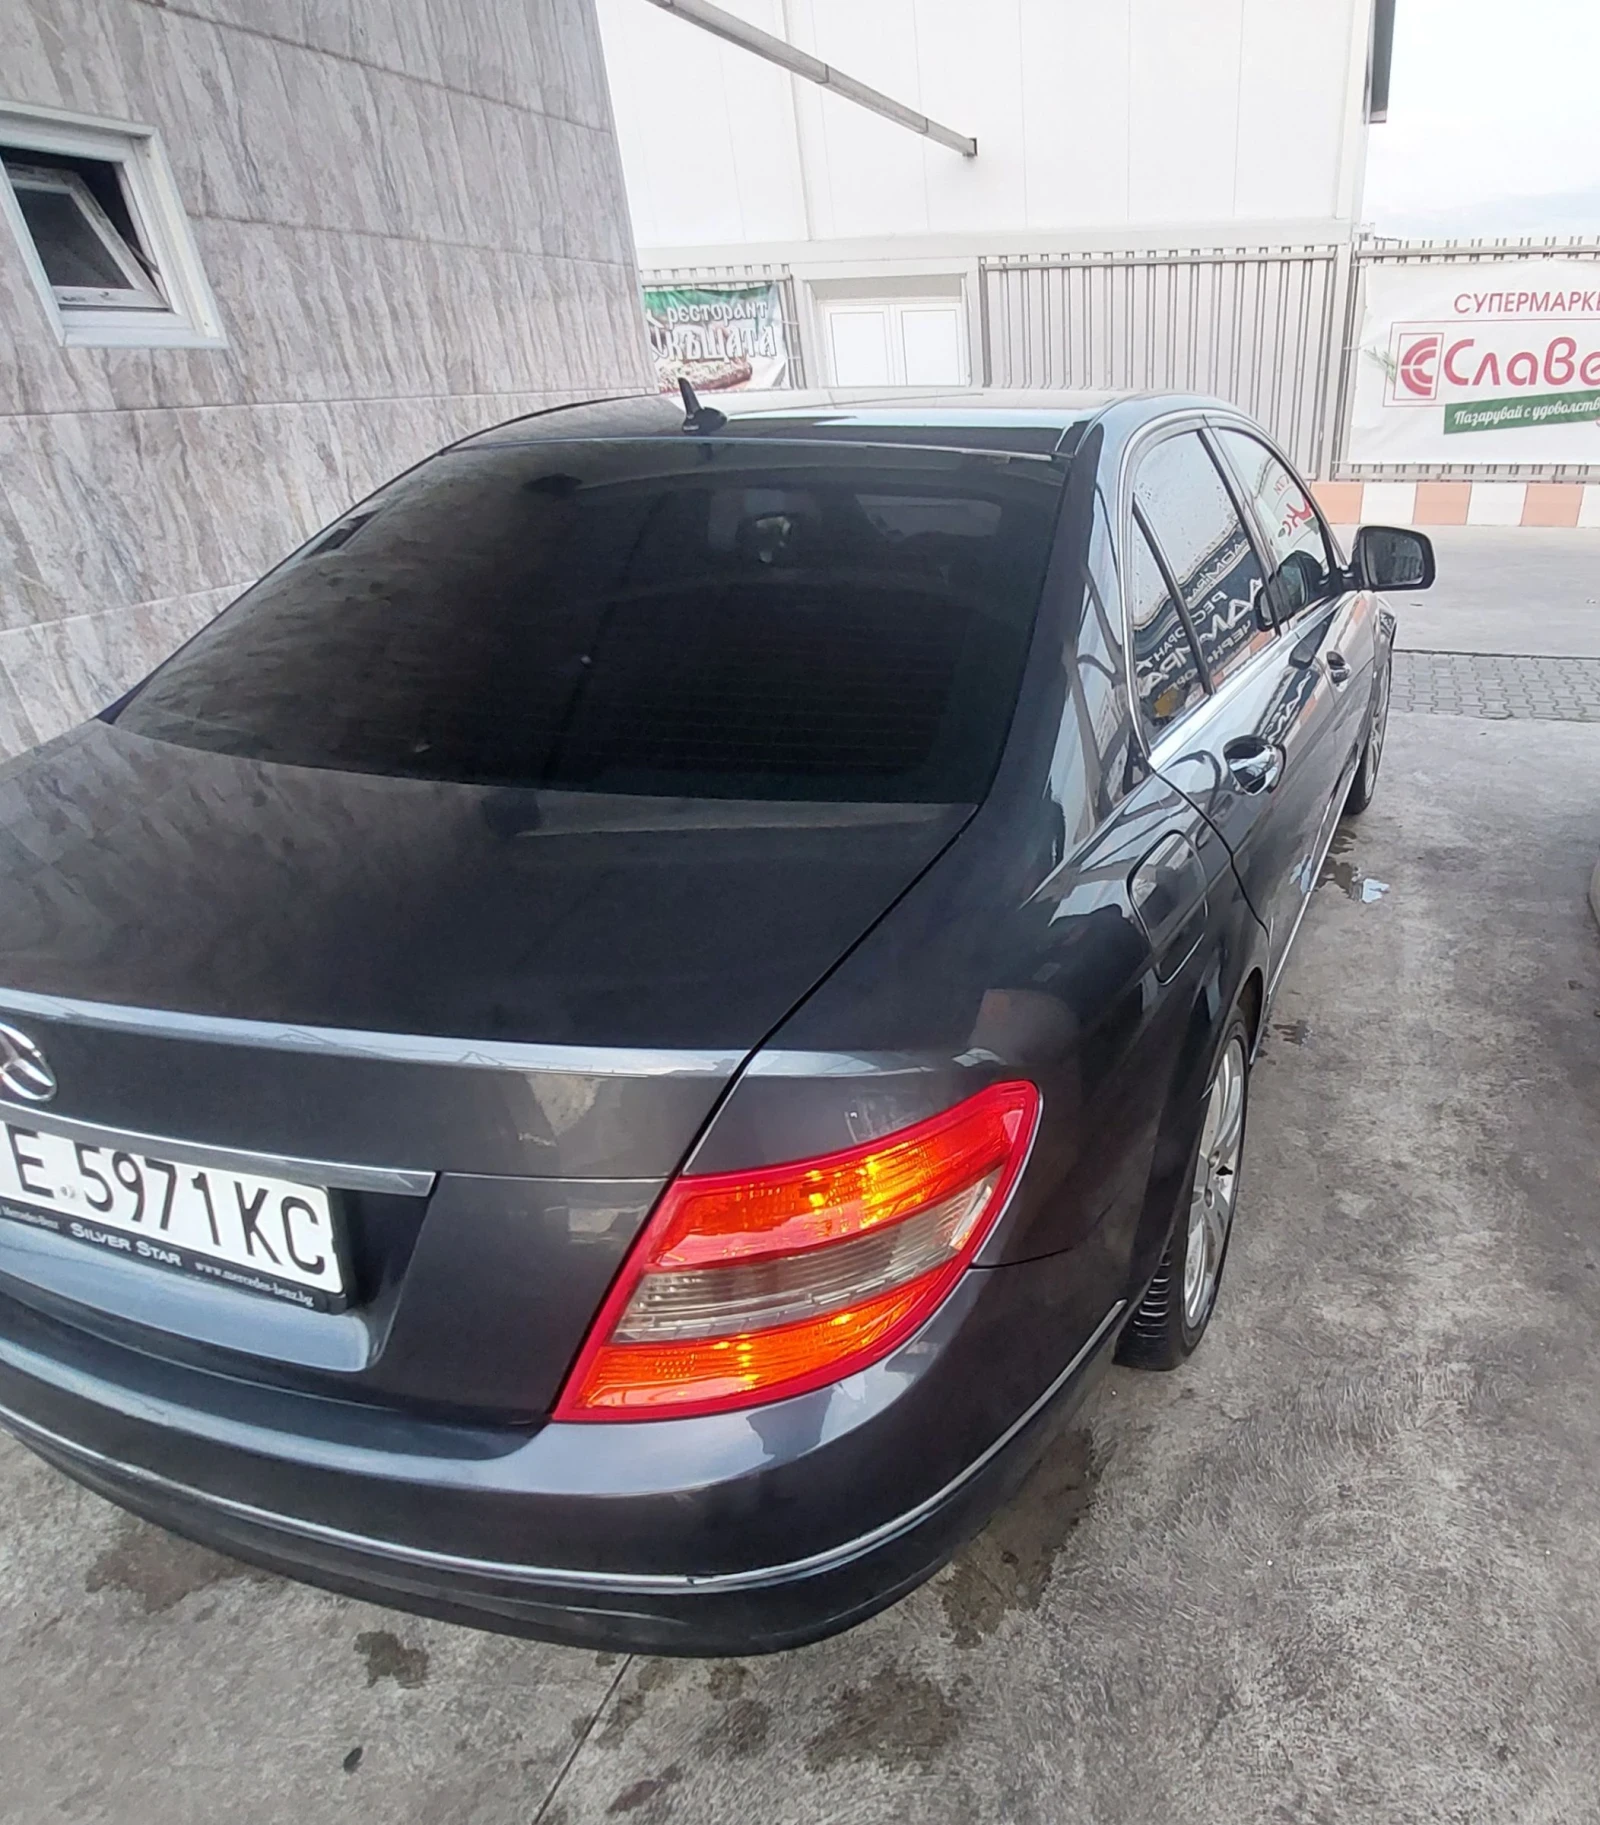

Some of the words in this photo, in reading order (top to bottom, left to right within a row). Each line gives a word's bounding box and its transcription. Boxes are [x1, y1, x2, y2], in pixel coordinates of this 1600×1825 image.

[1454, 405, 1523, 426] Пазарувай
[1523, 407, 1531, 417] с
[74, 1142, 222, 1247] 5971
[70, 1221, 131, 1251] SILVER
[136, 1239, 183, 1267] STAR
